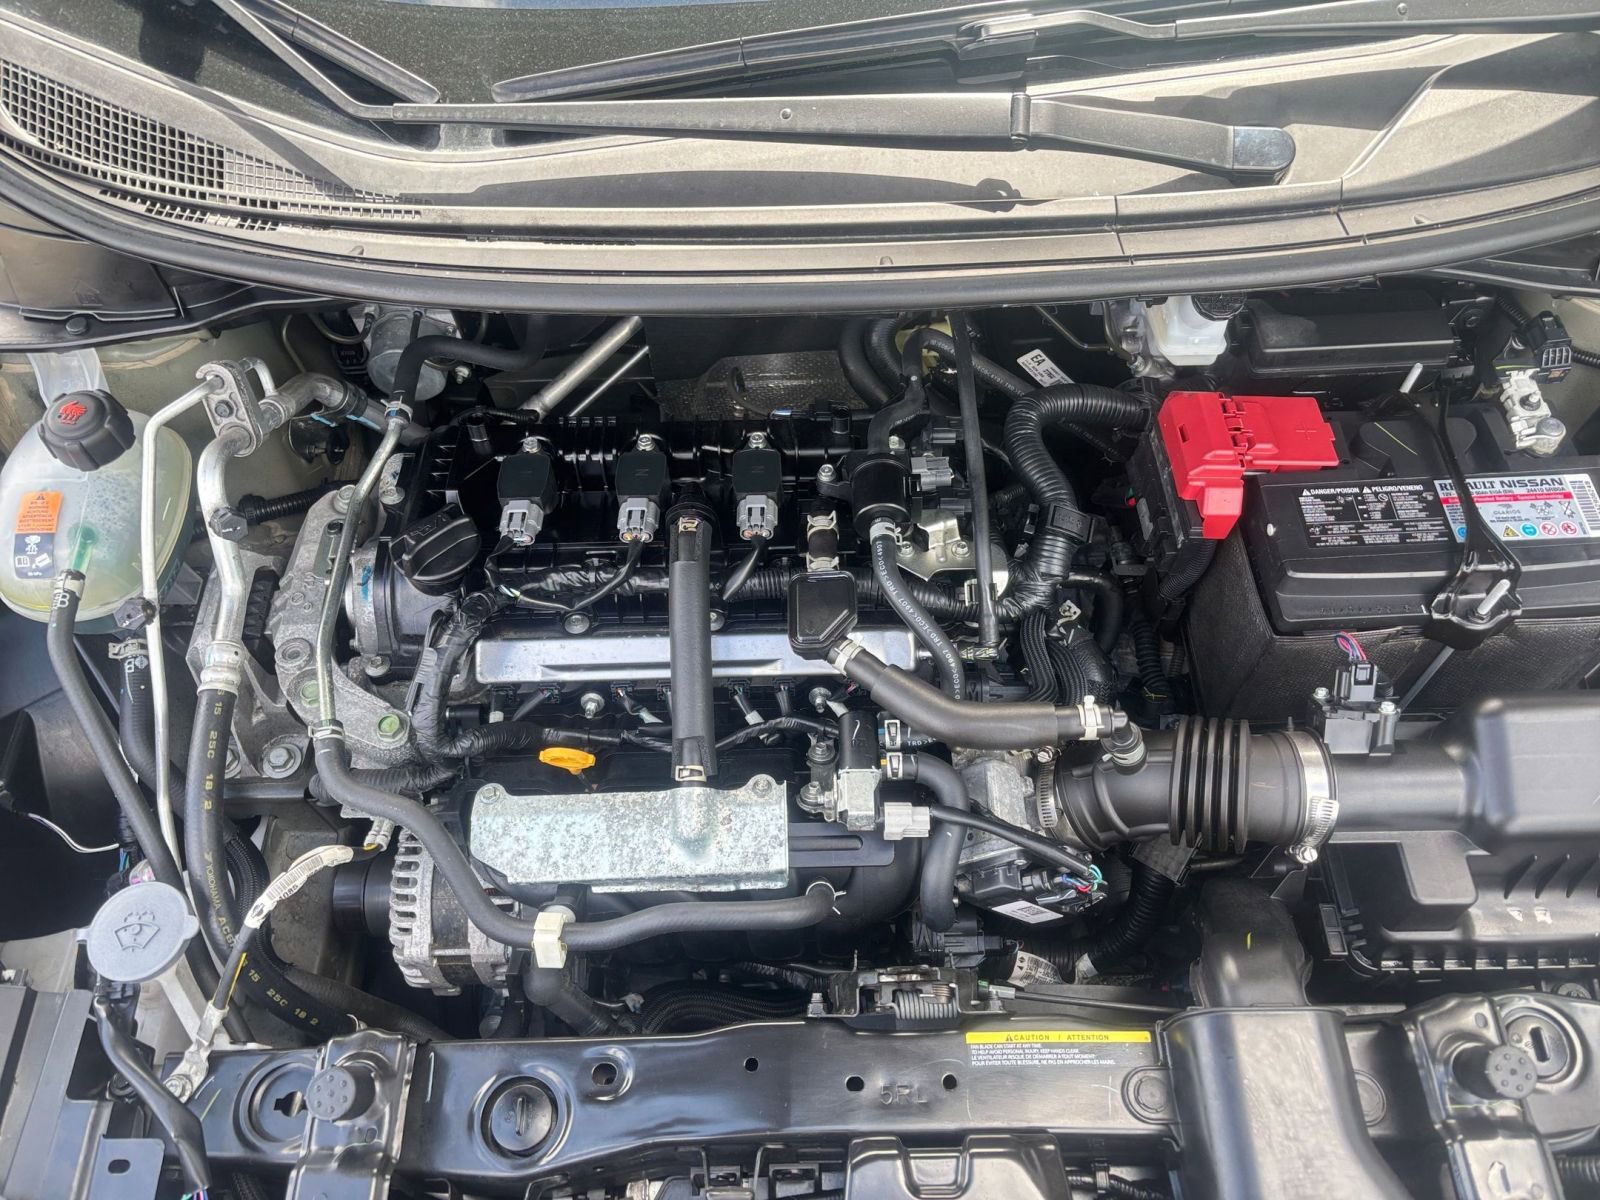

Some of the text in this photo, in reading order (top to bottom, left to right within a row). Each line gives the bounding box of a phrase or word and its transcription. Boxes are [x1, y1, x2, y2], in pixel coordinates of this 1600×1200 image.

[1030, 353, 1046, 367] EA
[1371, 484, 1424, 493] PELIGRO/VENENO
[1500, 477, 1564, 489] NISSAN
[1310, 487, 1360, 495] DANGER/POISON
[207, 730, 218, 759] 25C
[204, 800, 212, 810] 2
[206, 863, 222, 911] YOKOHAMA
[266, 988, 289, 1007] 25C
[880, 1083, 929, 1105] 5RL
